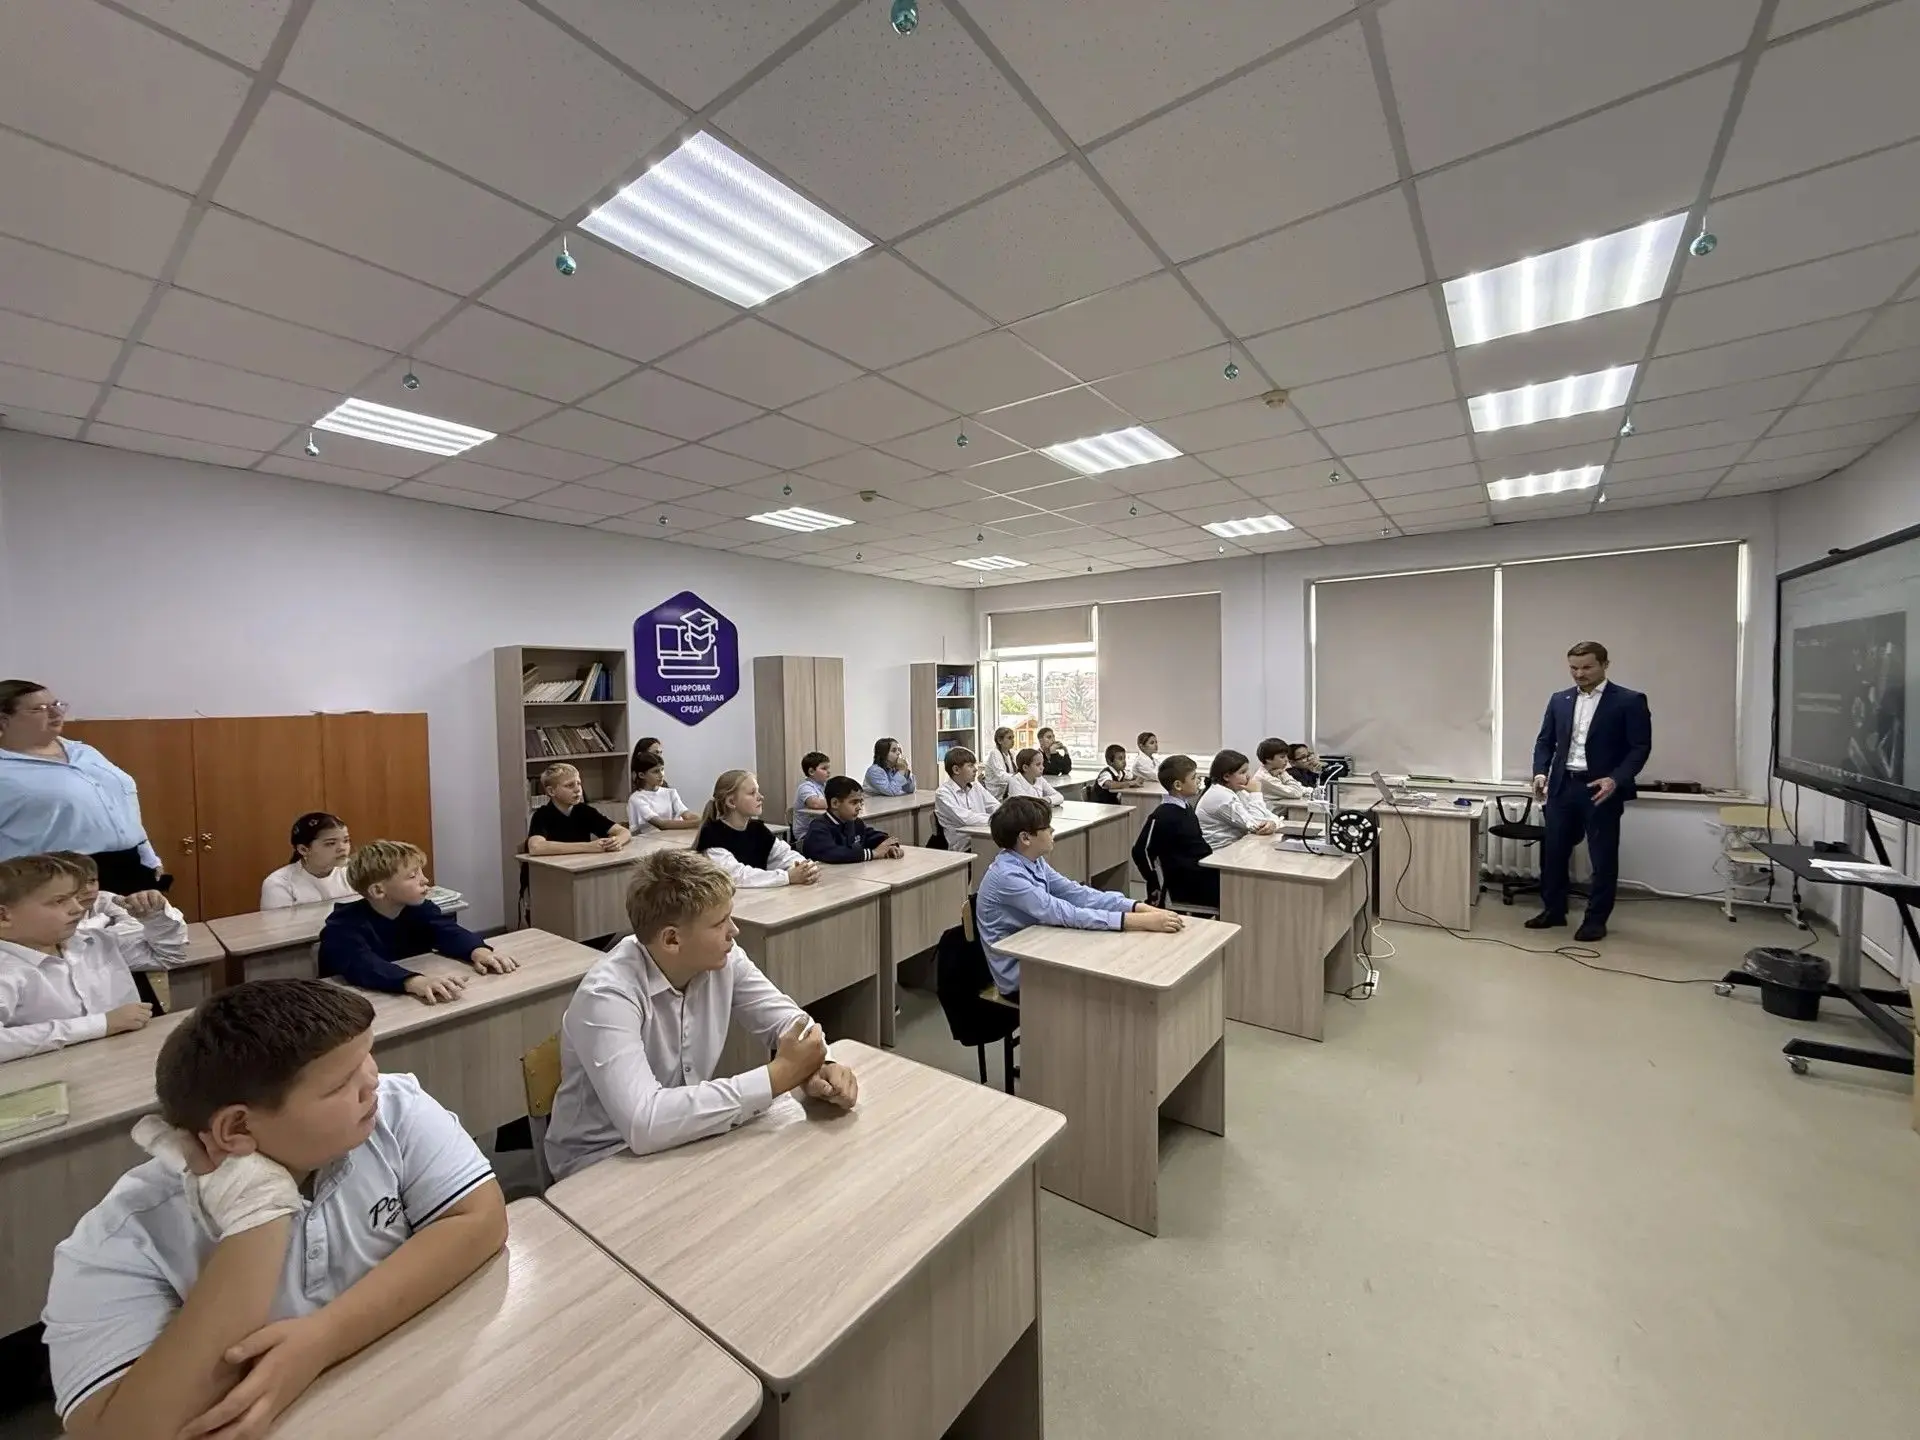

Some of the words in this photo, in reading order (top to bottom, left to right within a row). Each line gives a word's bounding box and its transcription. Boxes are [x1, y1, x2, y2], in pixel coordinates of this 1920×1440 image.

[671, 684, 711, 693] ЦИФРОВАЯ
[656, 694, 724, 703] ОБРАЗОВАТЕЛЬНАЯ
[680, 705, 703, 714] СРЕДА
[368, 1196, 400, 1228] Po
